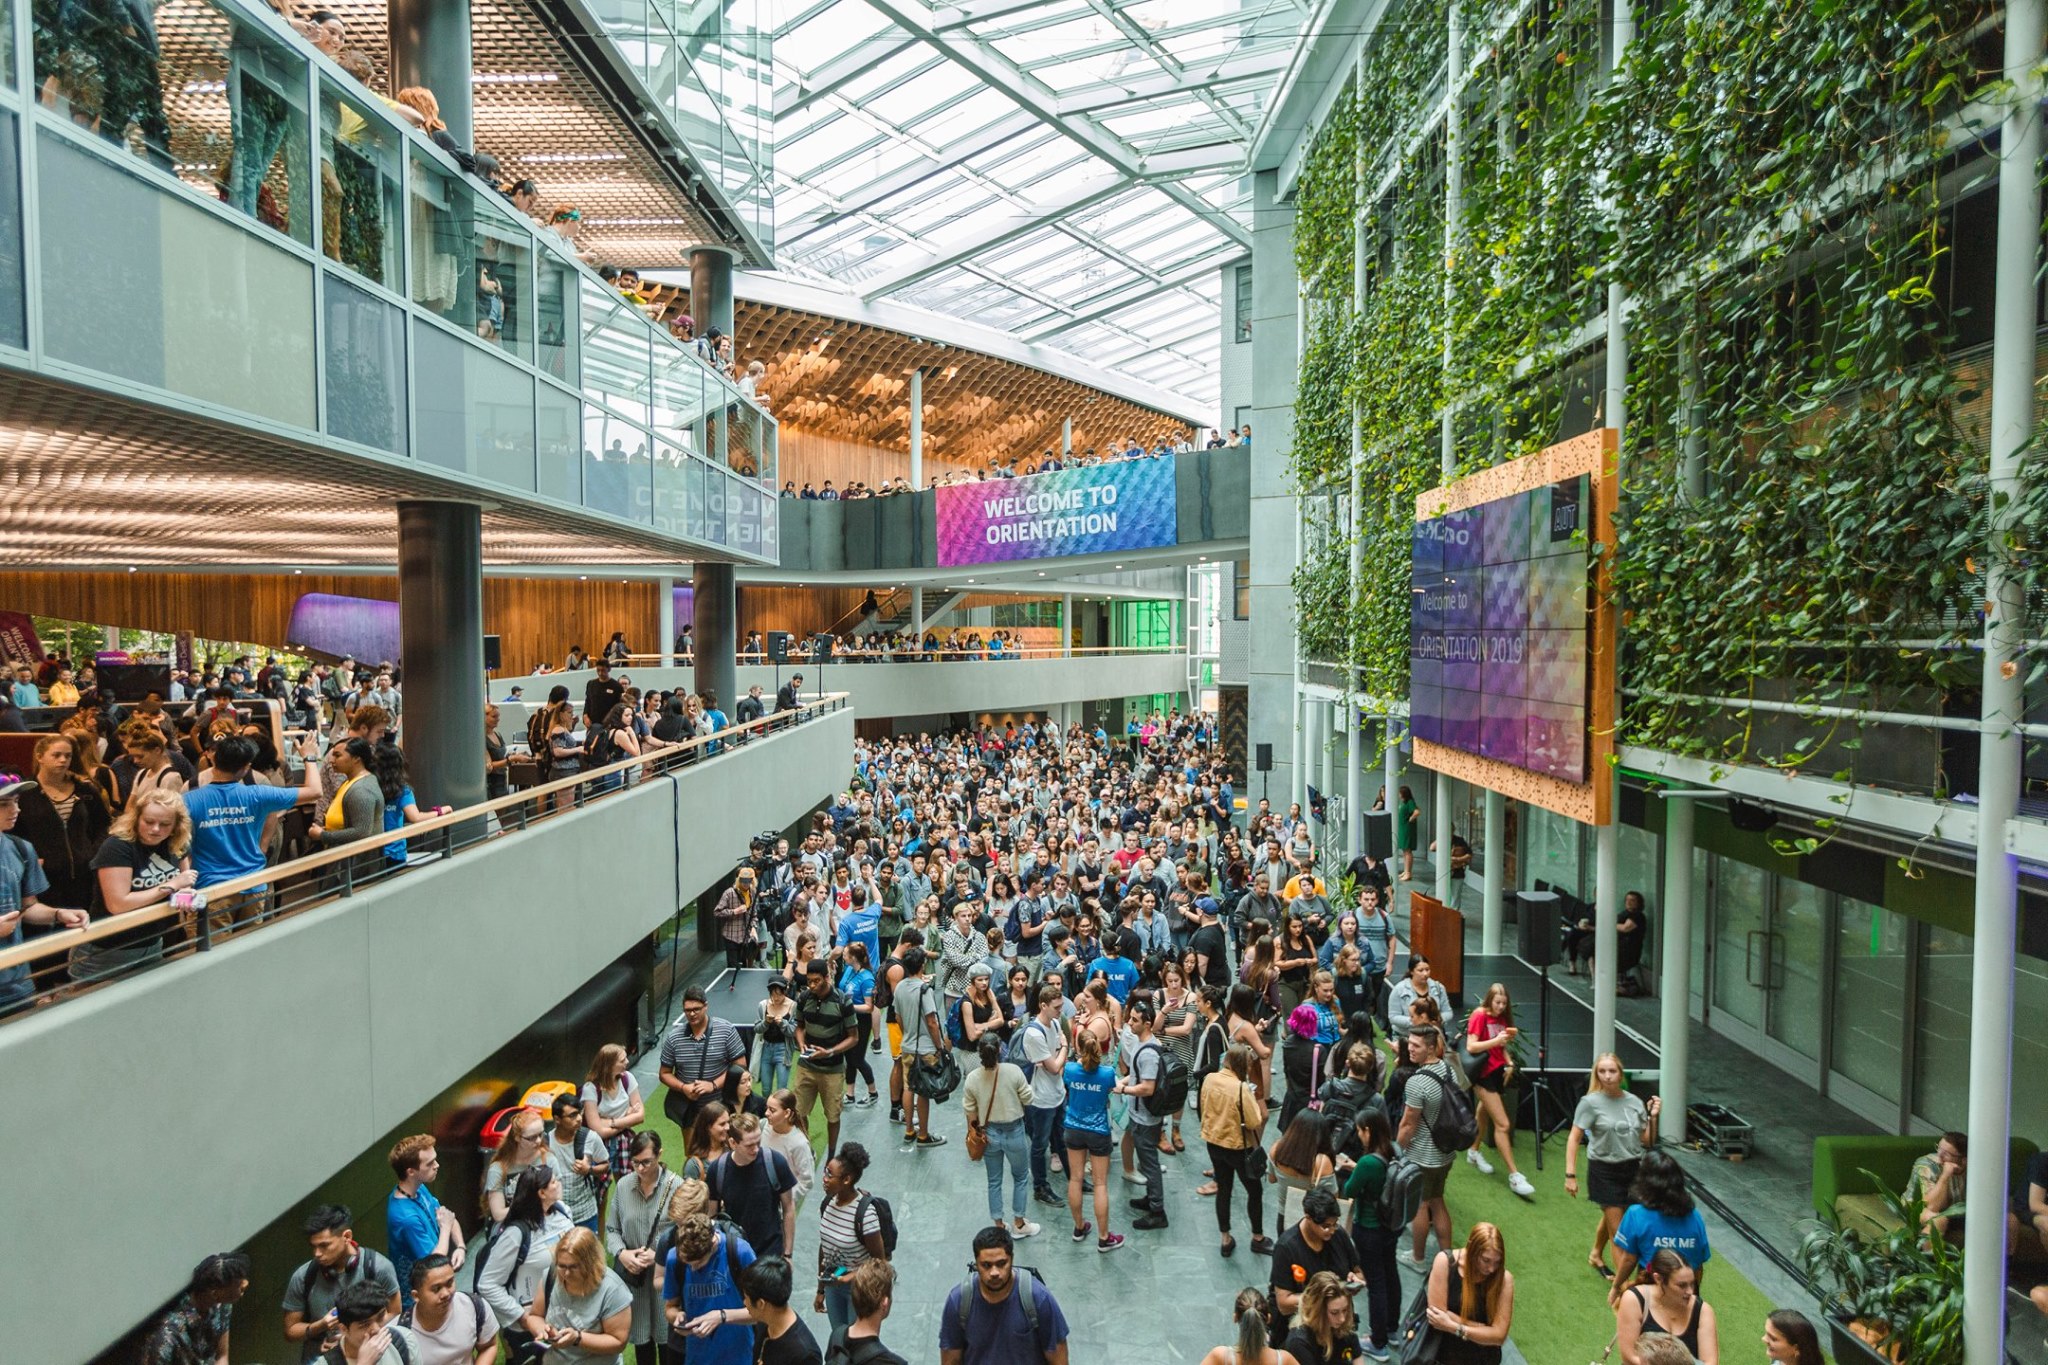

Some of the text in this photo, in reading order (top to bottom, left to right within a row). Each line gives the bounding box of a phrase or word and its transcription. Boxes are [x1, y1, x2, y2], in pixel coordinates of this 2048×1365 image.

[984, 484, 1117, 518] WELCOME TO
[1554, 504, 1576, 531] AUT
[986, 512, 1117, 545] ORIENTATION
[1419, 592, 1468, 611] Welcome to
[1418, 635, 1523, 664] ORIENTATION 2019
[208, 806, 248, 816] STUDENT
[199, 816, 255, 829] AMBASSADOR
[1114, 973, 1125, 981] ME
[1070, 1081, 1102, 1092] ASK ME
[1653, 1237, 1696, 1248] ASK ME
